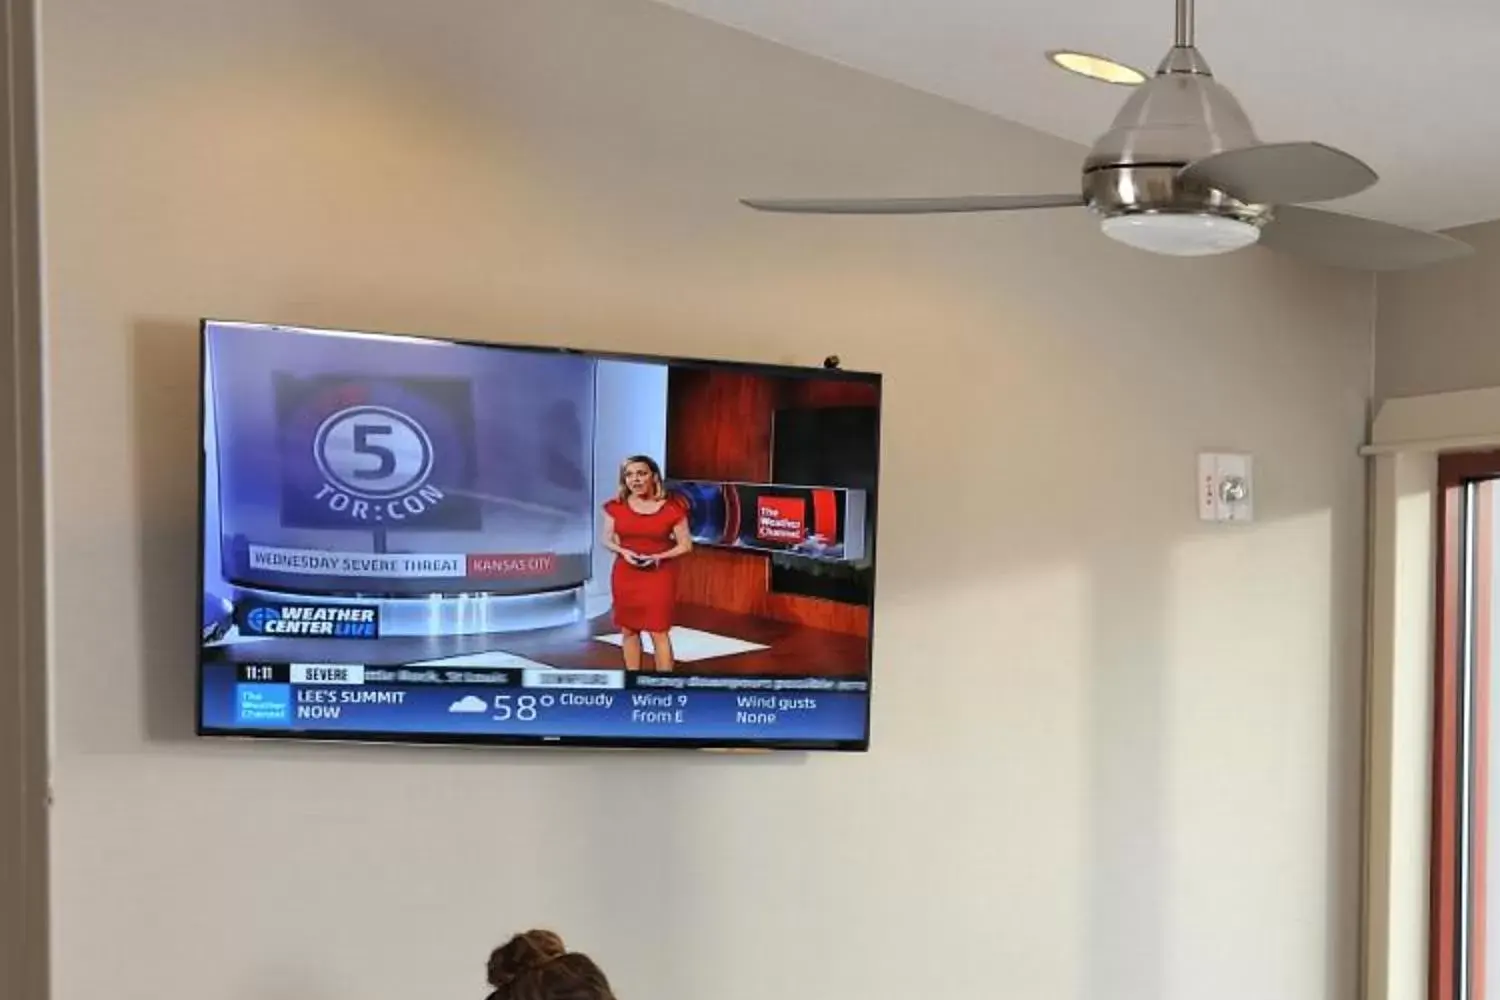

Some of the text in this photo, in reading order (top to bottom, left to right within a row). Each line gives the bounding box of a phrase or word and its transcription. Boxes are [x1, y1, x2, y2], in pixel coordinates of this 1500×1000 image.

[353, 424, 396, 480] 5
[255, 552, 459, 572] WEDNESDAY SEVERE THREAT
[473, 556, 552, 571] KANSAS CITY
[281, 606, 375, 622] WEATHER
[265, 619, 375, 636] CENTER LIVE
[246, 665, 273, 680] 11:11
[305, 667, 349, 681] SEVERE
[298, 689, 405, 704] LEE'S SUMMIT
[560, 692, 613, 708] Cloudy
[632, 694, 687, 707] Wind 9
[737, 695, 817, 711] Wind gusts
[297, 705, 340, 719] NOW
[632, 708, 683, 723] From E
[736, 710, 776, 724] None
